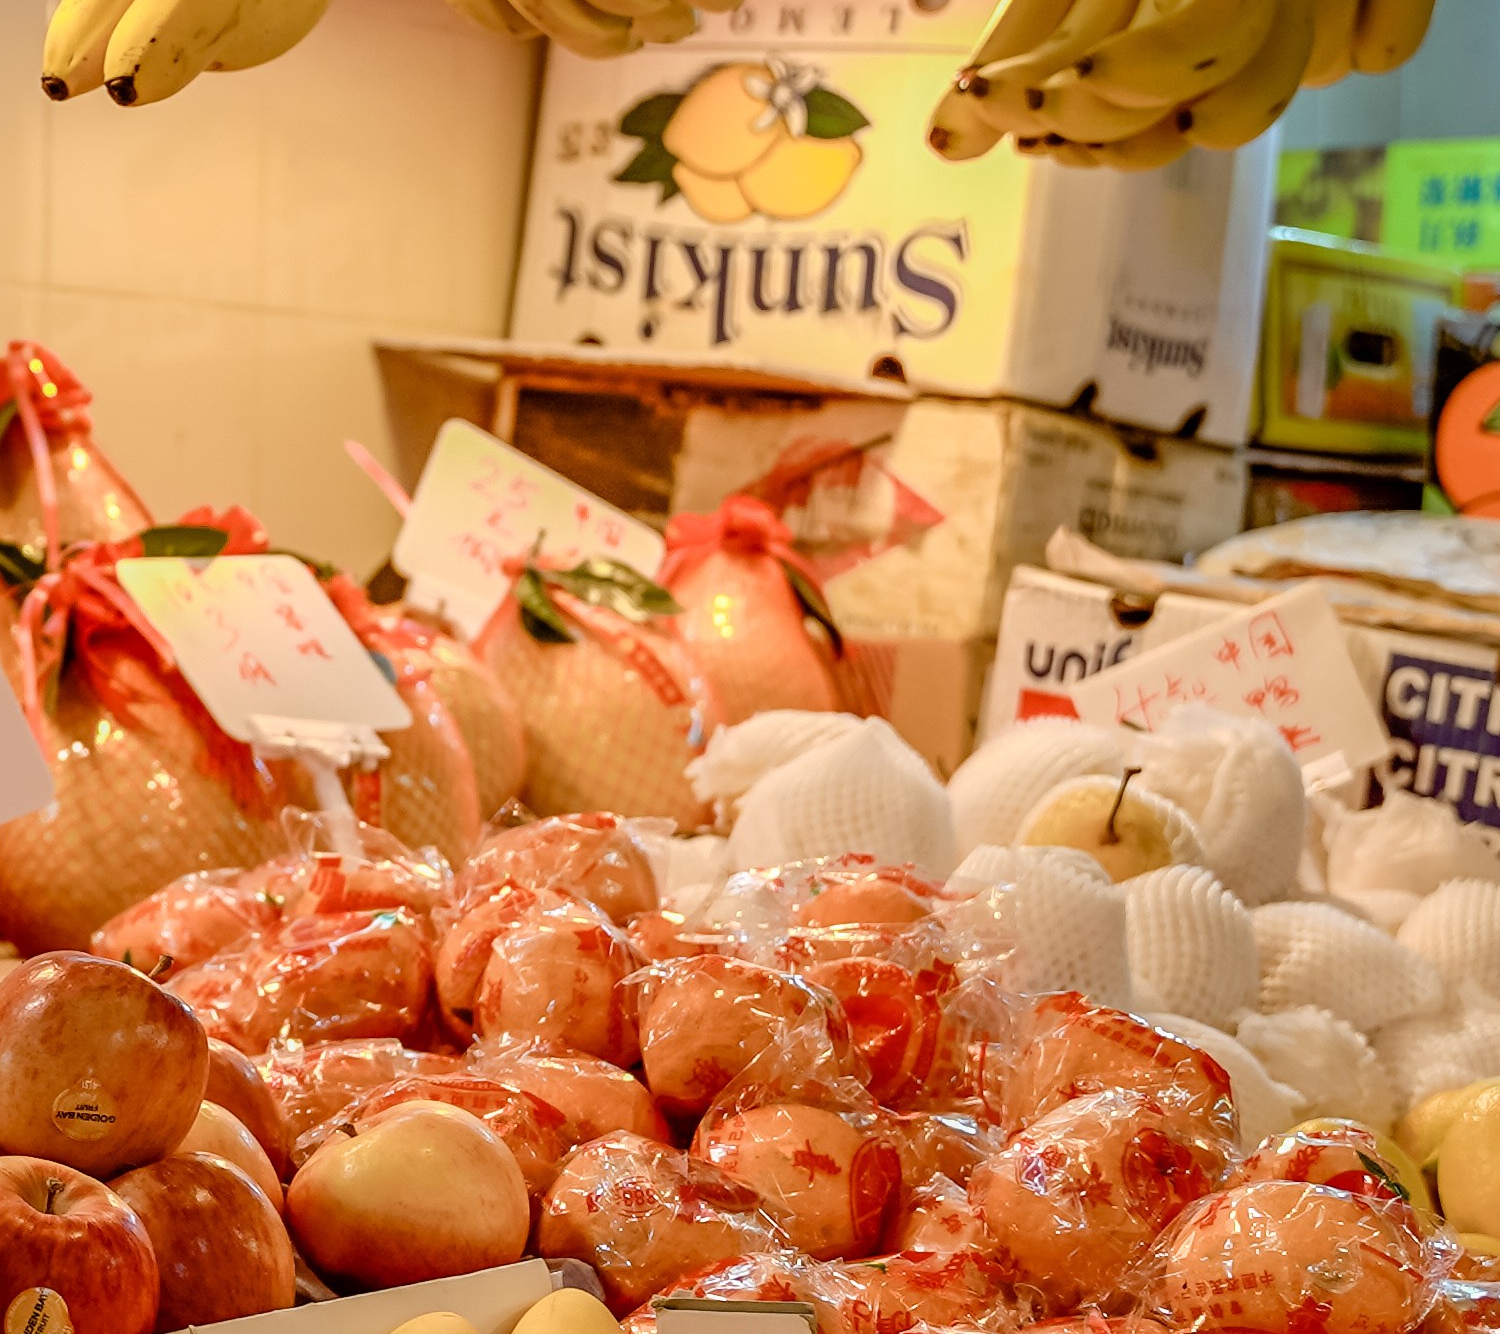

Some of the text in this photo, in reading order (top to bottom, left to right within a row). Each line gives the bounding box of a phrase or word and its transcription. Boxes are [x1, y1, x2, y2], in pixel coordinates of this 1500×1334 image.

[728, 4, 906, 37] LEMO
[552, 207, 973, 346] Sunkist
[56, 1110, 117, 1124] GOLDEN BAY
[74, 1104, 99, 1112] FRUIT
[37, 1293, 50, 1317] BAY
